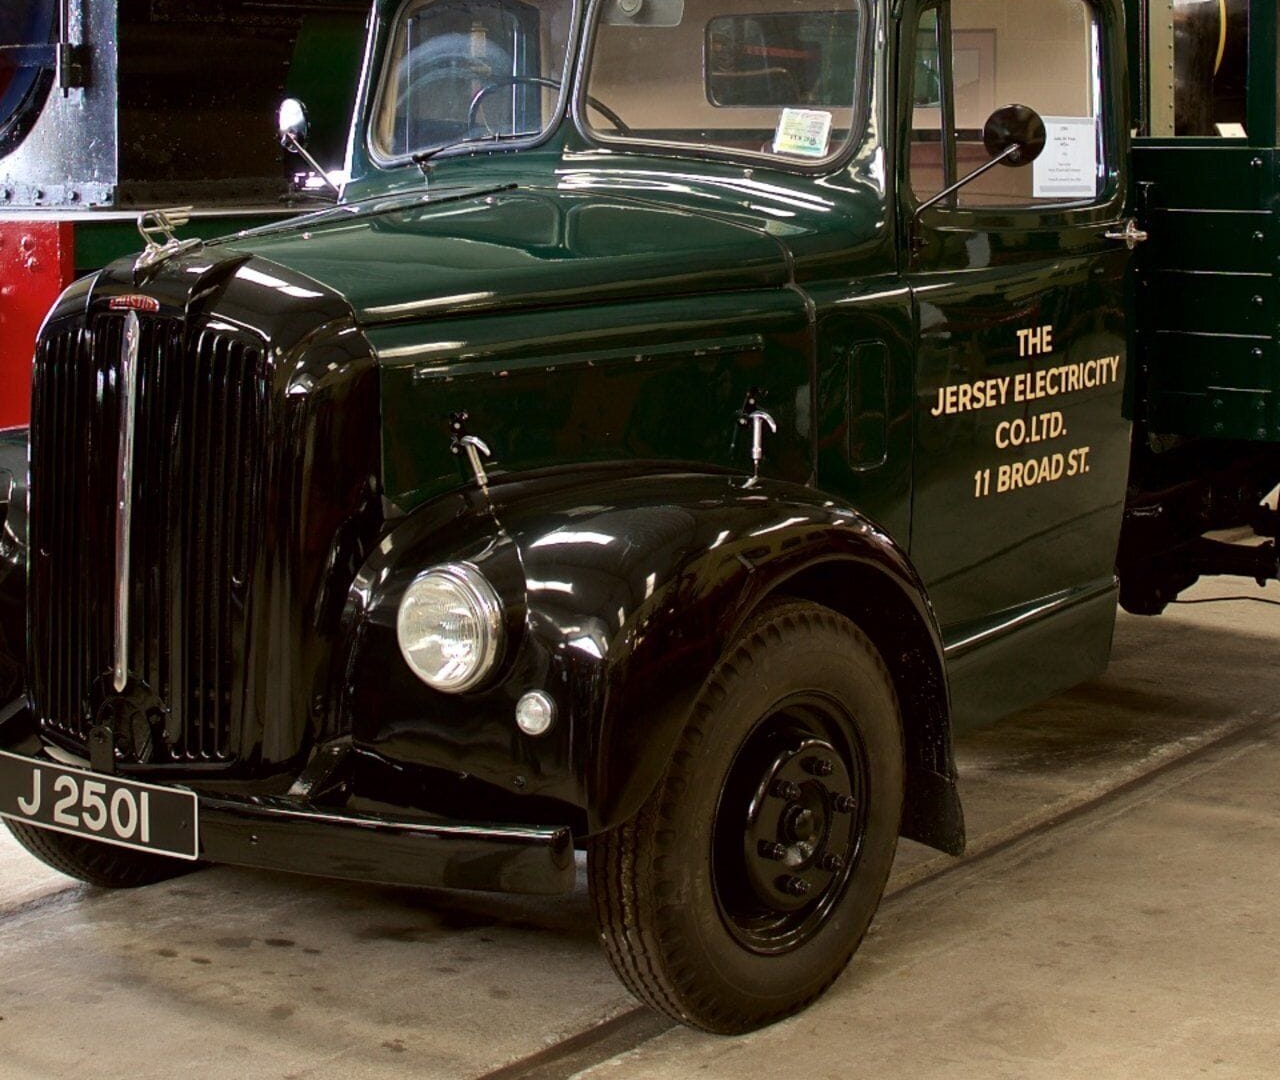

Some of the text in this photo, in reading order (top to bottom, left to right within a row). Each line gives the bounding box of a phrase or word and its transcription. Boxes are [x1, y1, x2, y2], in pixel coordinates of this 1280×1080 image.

[1016, 325, 1053, 357] THE
[931, 355, 1120, 416] JERSEY ELECTRICITY
[974, 446, 1090, 498] 11 BROAD ST.
[17, 769, 150, 843] J 2501
